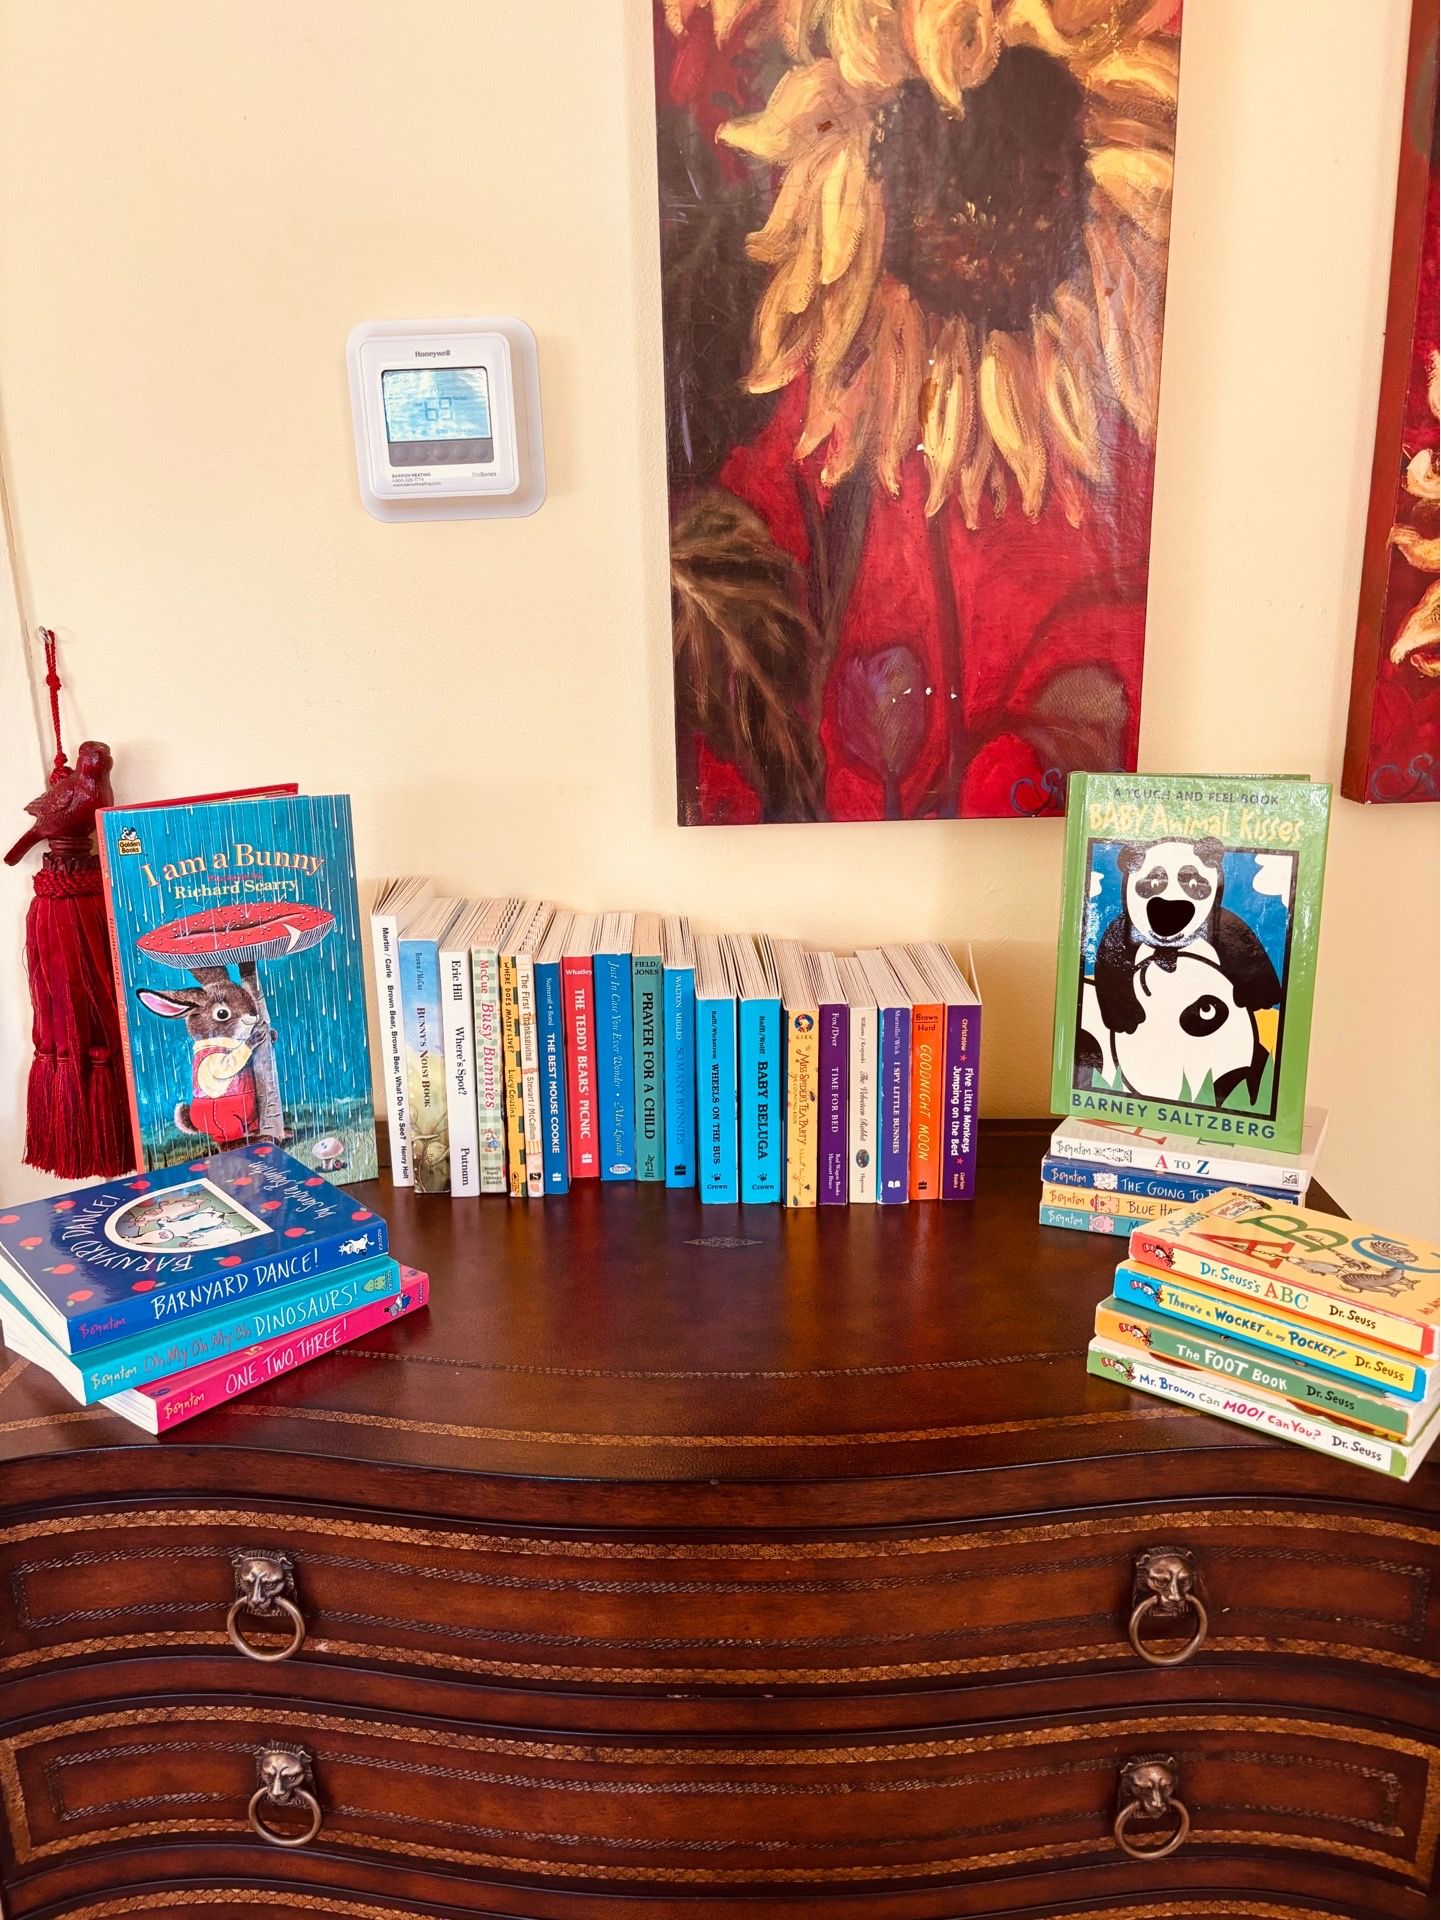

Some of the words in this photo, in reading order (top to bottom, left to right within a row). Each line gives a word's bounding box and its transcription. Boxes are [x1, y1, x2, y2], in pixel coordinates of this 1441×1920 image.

[415, 350, 450, 358] Honeywell
[1114, 788, 1122, 798] A
[1126, 788, 1170, 800] TOUCH
[1176, 790, 1203, 801] AND
[1209, 793, 1235, 803] FEEL
[1242, 794, 1279, 805] BOOK
[1088, 802, 1148, 832] BABY
[1150, 802, 1231, 837] Animal
[1239, 807, 1305, 844] Kisses
[122, 846, 140, 854] Books
[142, 863, 160, 887] I
[163, 856, 208, 881] am
[212, 853, 230, 870] a
[234, 843, 326, 876] Bunny
[174, 881, 240, 900] Richard
[244, 879, 298, 892] Scarry
[452, 960, 461, 982] Eric
[480, 960, 489, 994] McCue
[504, 962, 512, 984] WHERE
[520, 974, 530, 988] The
[608, 960, 619, 979] Just
[611, 981, 620, 990] In
[453, 984, 463, 1000] Hill
[522, 991, 532, 1009] First
[546, 978, 554, 1006] Numeroff
[574, 988, 586, 1011] THE
[611, 994, 620, 1012] Case
[382, 928, 392, 952] Martin
[396, 1096, 403, 1106] Do
[416, 1008, 428, 1046] BUNNY'S
[480, 1002, 494, 1040] Busy
[576, 1014, 587, 1052] TEDDY
[612, 1013, 622, 1030] You
[642, 992, 654, 1046] PRAYER
[830, 1013, 840, 1046] Fox/Dyer
[455, 1027, 465, 1066] Where's
[522, 1012, 532, 1061] Thanksgiving
[547, 1033, 555, 1052] THE
[612, 1032, 622, 1053] Ever
[420, 1050, 429, 1078] NOISY
[548, 1056, 556, 1078] BEST
[644, 1052, 654, 1079] FOR
[676, 1047, 684, 1060] SO
[456, 1068, 468, 1096] Spot?
[483, 1046, 496, 1108] Bunnies
[578, 1056, 589, 1096] BEARS'
[614, 1056, 623, 1088] Wonder
[676, 1061, 684, 1094] MANY
[758, 1061, 768, 1098] BABY
[918, 1044, 932, 1118] GOODNIGHT
[950, 1066, 962, 1104] Jumping
[964, 1068, 974, 1086] Five
[422, 1080, 431, 1108] BOOK
[526, 1077, 534, 1102] Stewart
[549, 1081, 558, 1115] MOUSE
[644, 1084, 654, 1093] A
[964, 1090, 973, 1112] Little
[528, 1108, 536, 1140] McCallum
[580, 1100, 590, 1139] PICNIC
[614, 1102, 624, 1126] Max
[644, 1098, 655, 1140] CHILD
[676, 1097, 684, 1144] BUNNIES
[712, 1106, 720, 1120] ON
[952, 1107, 959, 1118] on
[952, 1121, 960, 1136] the
[1072, 1093, 1148, 1118] BARNEY
[1157, 1107, 1276, 1140] SALTZBERG
[550, 1117, 560, 1154] COOKIE
[614, 1128, 624, 1156] Lucado
[758, 1104, 768, 1160] BELUGA
[918, 1124, 930, 1160] MOON
[950, 1138, 959, 1156] Bed
[961, 1115, 972, 1154] Monkeys
[1056, 1140, 1092, 1156] Boynton
[1155, 1154, 1168, 1169] A
[1174, 1160, 1190, 1170] TO
[1197, 1160, 1210, 1175] Z
[1051, 1168, 1086, 1183] Boynton
[1121, 1178, 1144, 1193] THE
[1147, 1181, 1185, 1200] GOING
[1048, 1210, 1083, 1226] Boynton
[1050, 1190, 1085, 1204] Boynton
[1126, 1201, 1156, 1216] BLUE
[79, 1316, 126, 1338] Boynton
[150, 1274, 250, 1320] BARNYARD
[252, 1248, 320, 1286] DANCE!
[1200, 1262, 1218, 1278] Dr.
[1220, 1268, 1261, 1293] Seuss's
[1264, 1282, 1310, 1310] ABC
[1328, 1304, 1344, 1318] Dr.
[1347, 1310, 1376, 1330] Seuss
[90, 1366, 138, 1390] Boynton
[144, 1352, 164, 1373] Oh
[168, 1345, 188, 1366] My
[190, 1338, 208, 1356] Oh
[212, 1331, 232, 1352] My
[234, 1323, 252, 1342] Oh
[252, 1282, 359, 1336] DINOSAURS!
[1167, 1292, 1202, 1314] There's
[1213, 1308, 1266, 1332] WOCKET
[1288, 1330, 1348, 1360] POCKET!
[163, 1393, 205, 1419] Boynton
[225, 1366, 264, 1395] ONE,
[263, 1347, 298, 1375] TWO,
[299, 1318, 348, 1356] THREE!
[1176, 1344, 1200, 1362] The
[1203, 1348, 1248, 1377] FOOT
[1140, 1374, 1157, 1387] Mr.
[1158, 1376, 1196, 1399] Brown
[1198, 1392, 1220, 1408] Can
[1222, 1400, 1265, 1422] MOO!
[1268, 1414, 1290, 1430] Can
[1290, 1420, 1322, 1440] You?
